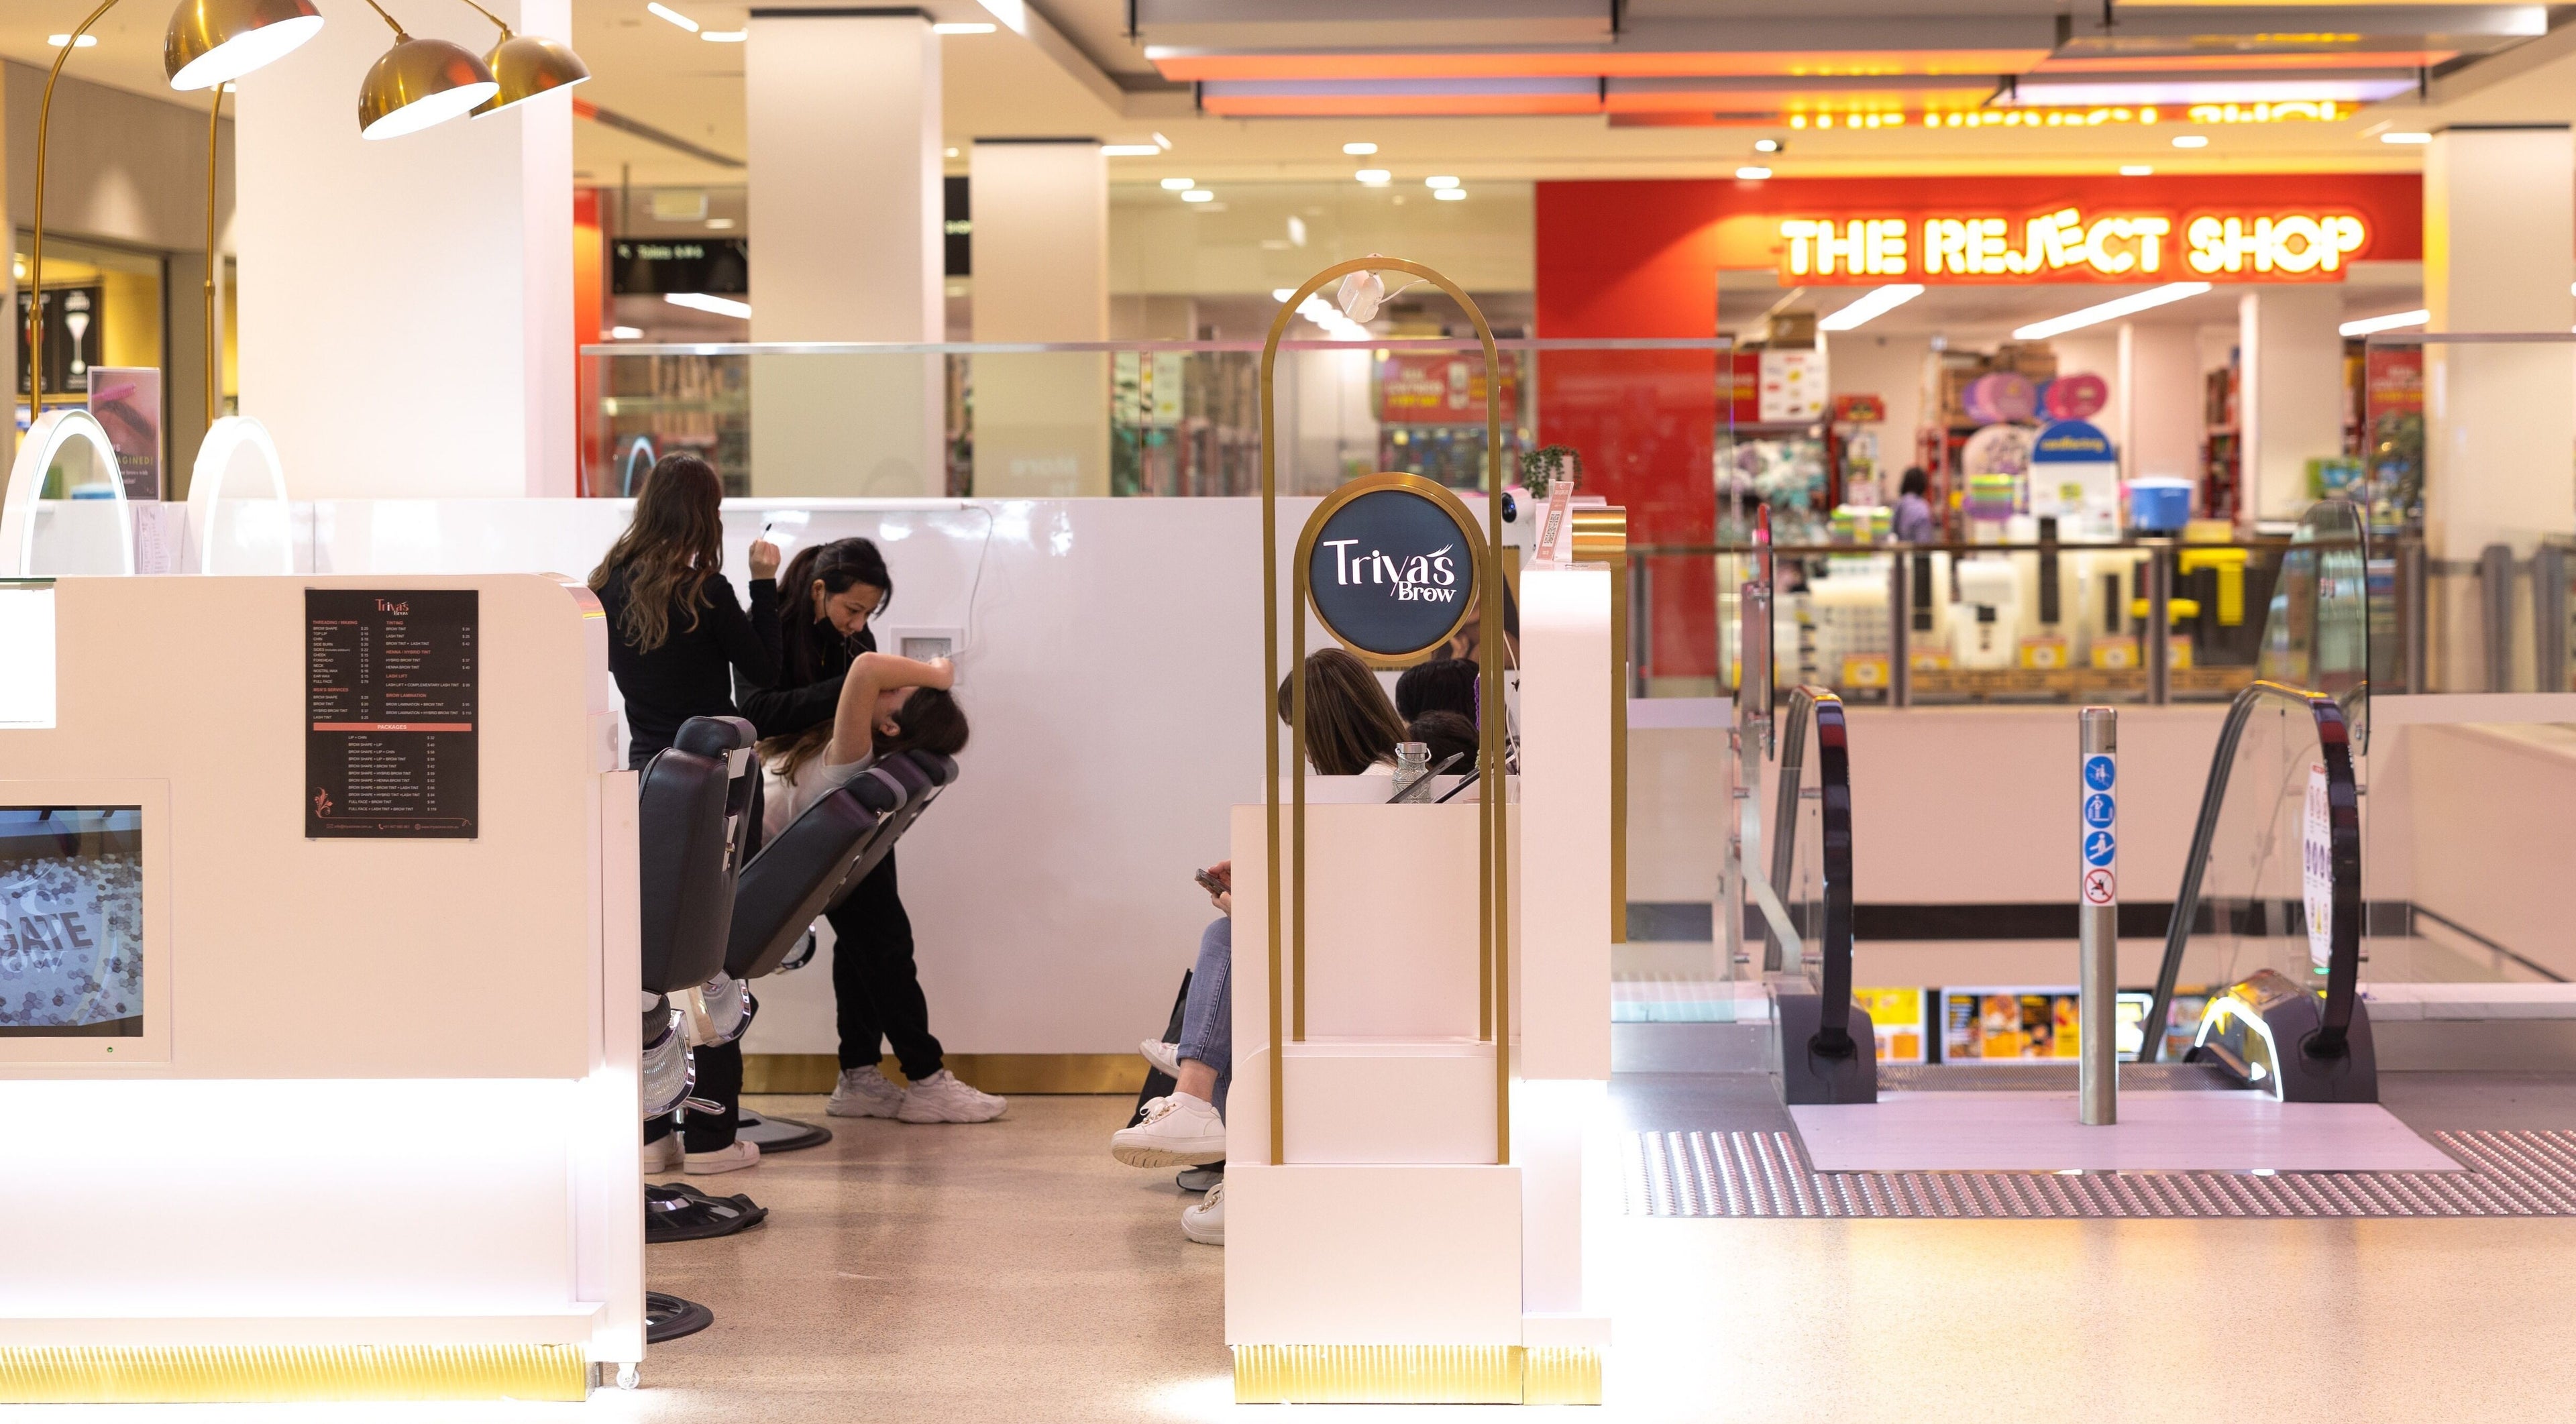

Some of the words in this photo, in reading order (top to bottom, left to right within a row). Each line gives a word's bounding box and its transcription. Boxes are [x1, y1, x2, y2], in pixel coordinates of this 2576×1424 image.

[1780, 219, 1907, 275] THE
[1924, 208, 2169, 275] REJECT
[2188, 216, 2365, 274] SHOP
[117, 456, 153, 465] AGINED!
[1398, 581, 1456, 603] Brow
